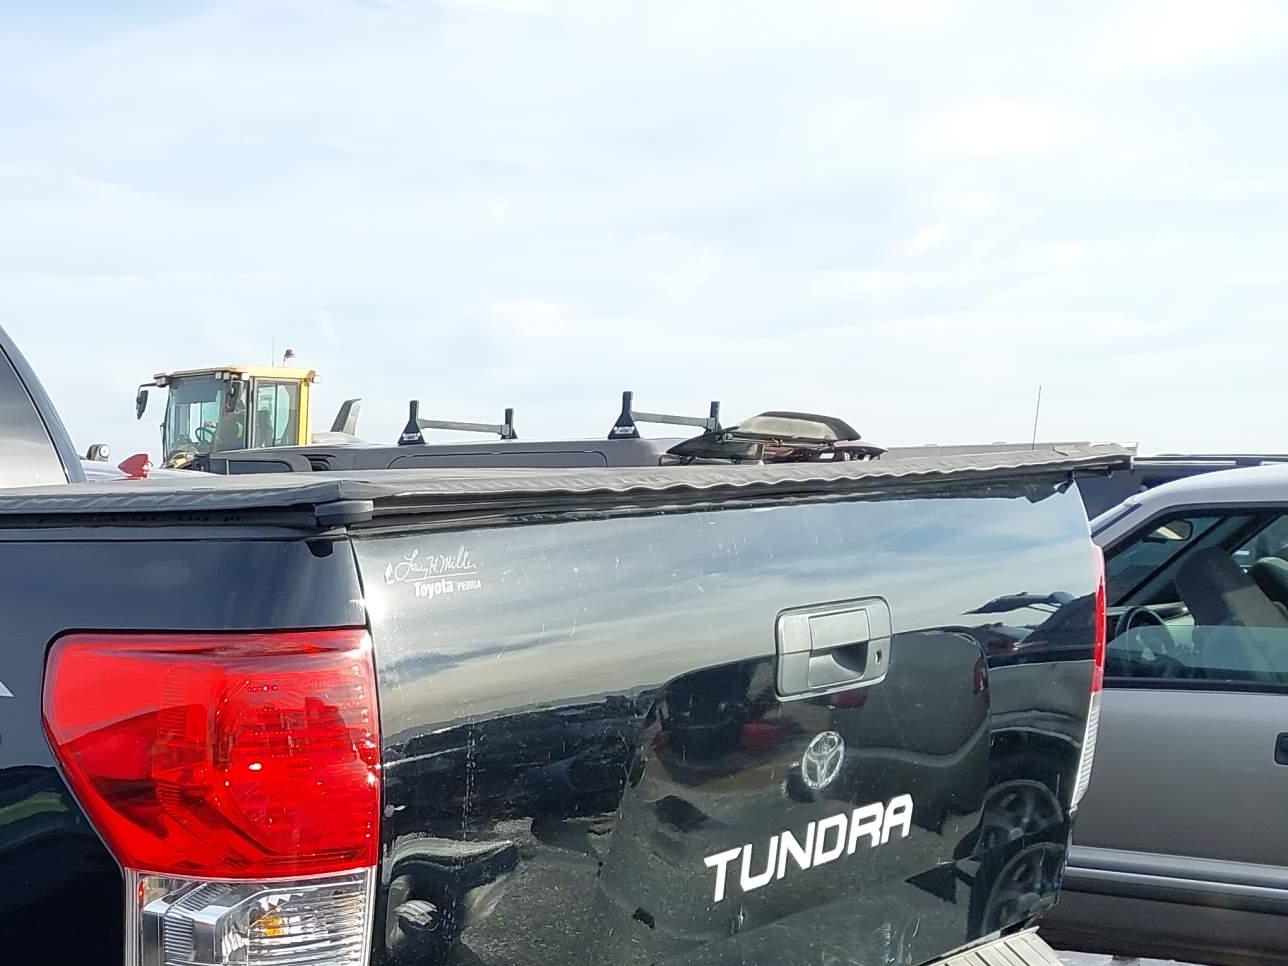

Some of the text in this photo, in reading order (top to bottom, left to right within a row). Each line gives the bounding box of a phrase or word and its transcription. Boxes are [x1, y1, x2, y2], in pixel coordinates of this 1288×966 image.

[413, 578, 482, 599] Toyota PEORIA
[703, 793, 914, 903] TUNDRA
